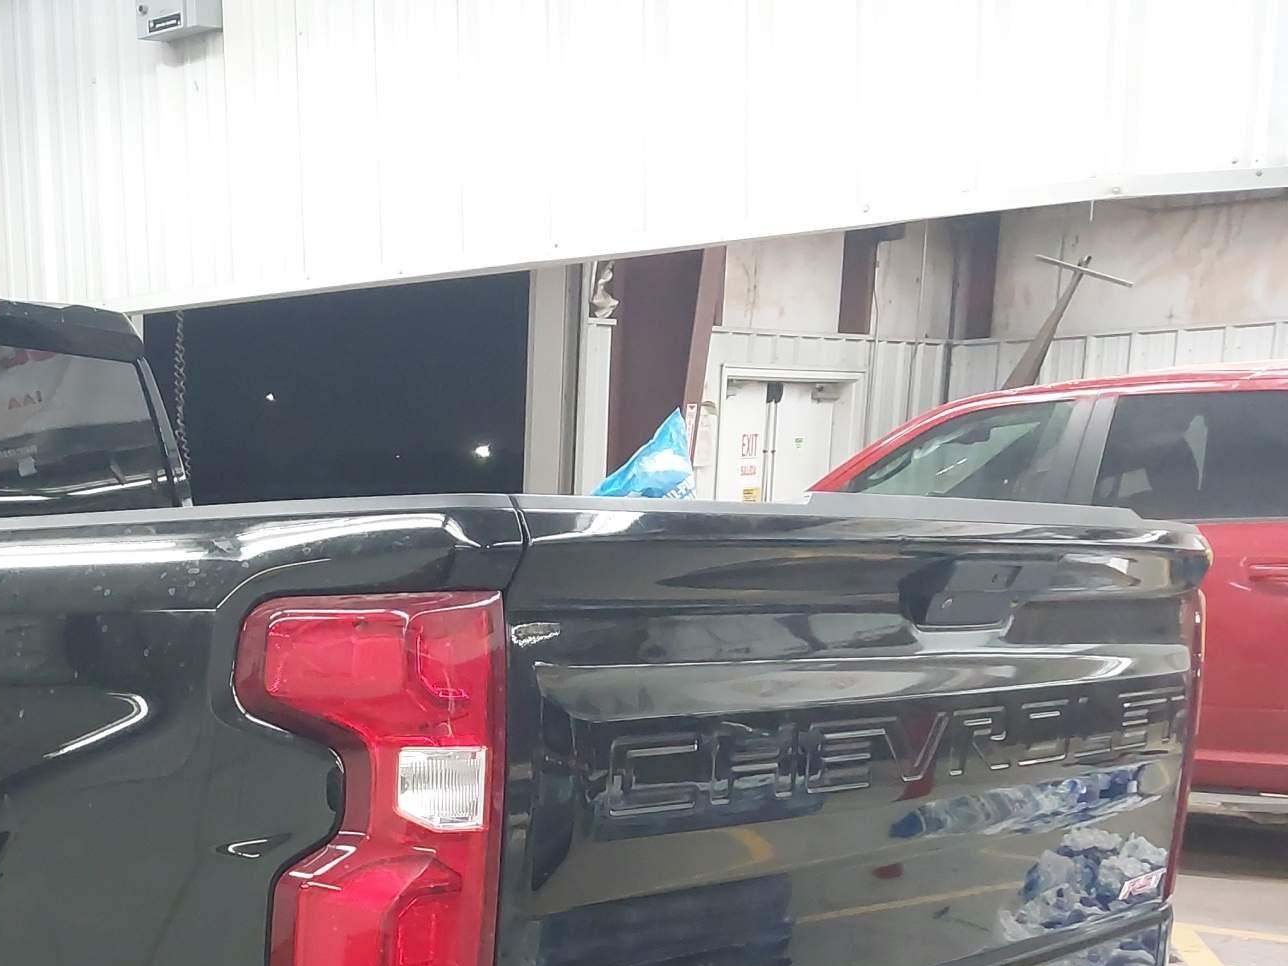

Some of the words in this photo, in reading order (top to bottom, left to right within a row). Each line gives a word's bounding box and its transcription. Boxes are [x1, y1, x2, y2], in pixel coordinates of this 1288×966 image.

[741, 433, 759, 457] EXIT
[609, 687, 1186, 816] CHEVROLET
[1118, 867, 1167, 900] RST
